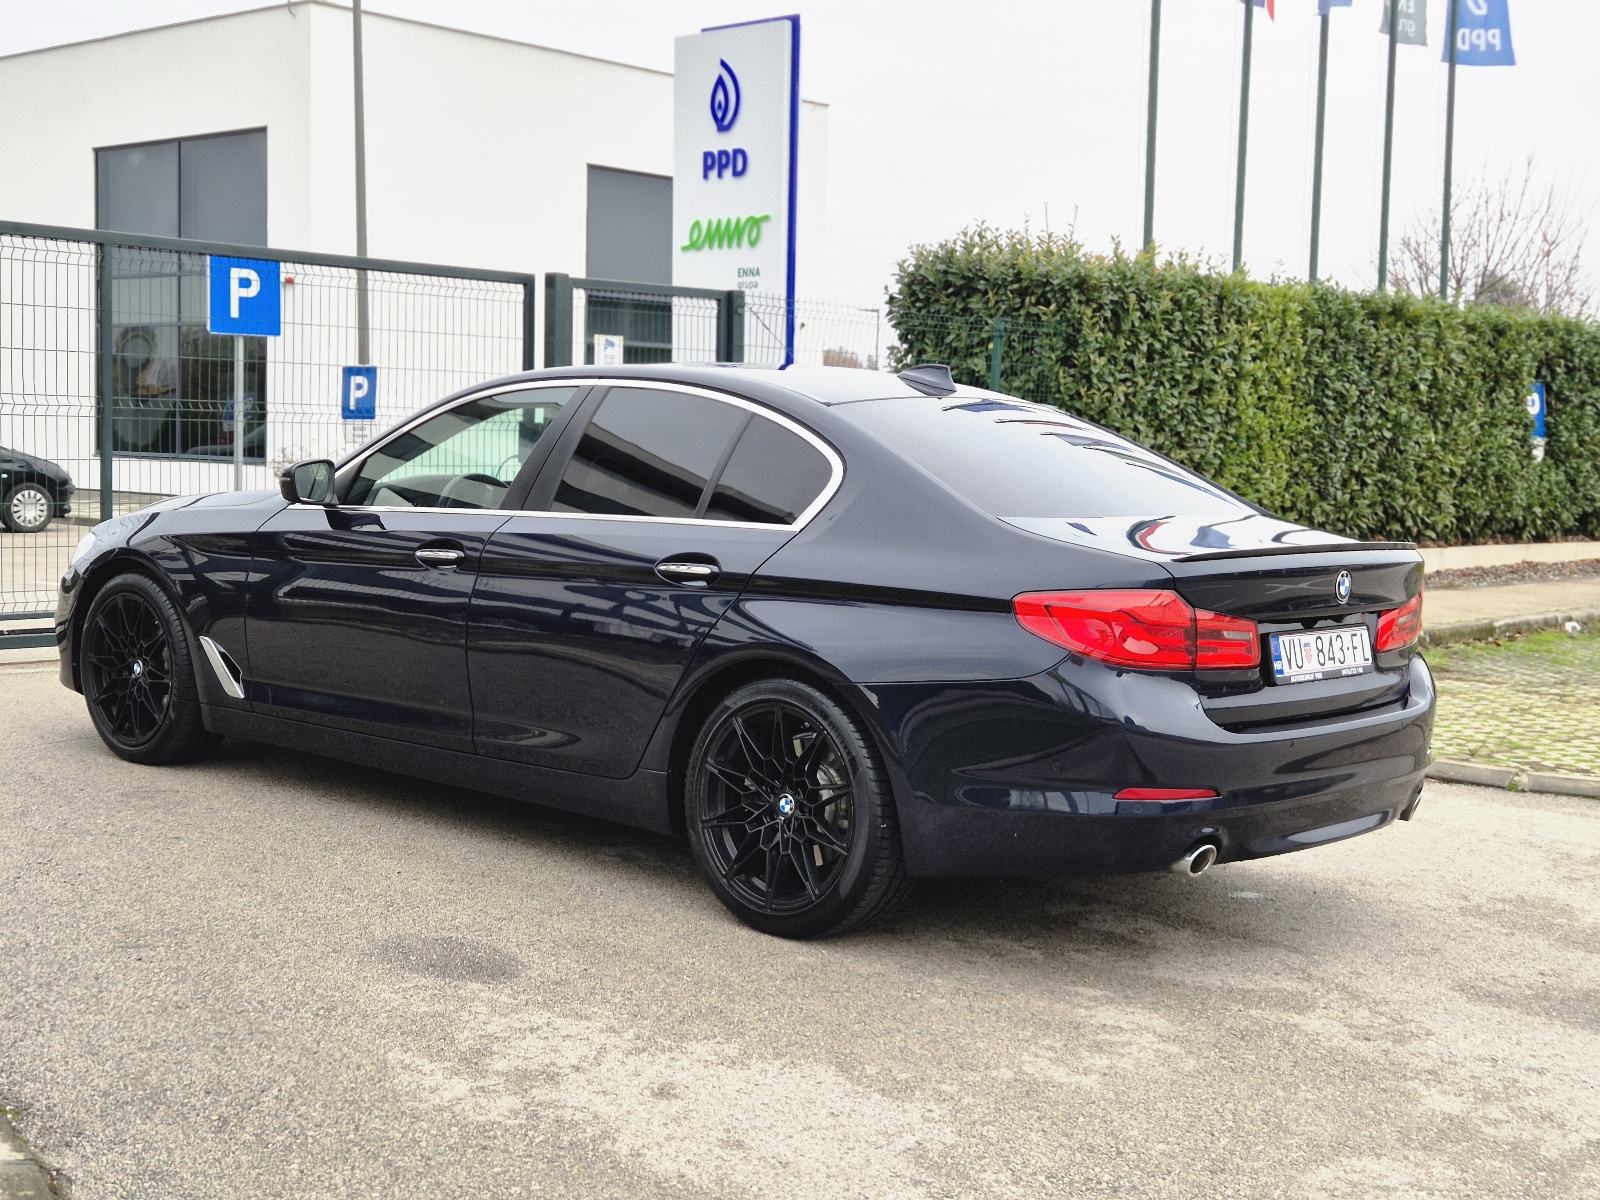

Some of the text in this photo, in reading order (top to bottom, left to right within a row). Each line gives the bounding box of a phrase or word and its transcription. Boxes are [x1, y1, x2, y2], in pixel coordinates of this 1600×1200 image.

[702, 148, 748, 180] PPD
[737, 266, 761, 278] ENNA
[230, 267, 261, 318] P
[349, 375, 369, 410] P
[1282, 637, 1304, 670] VU
